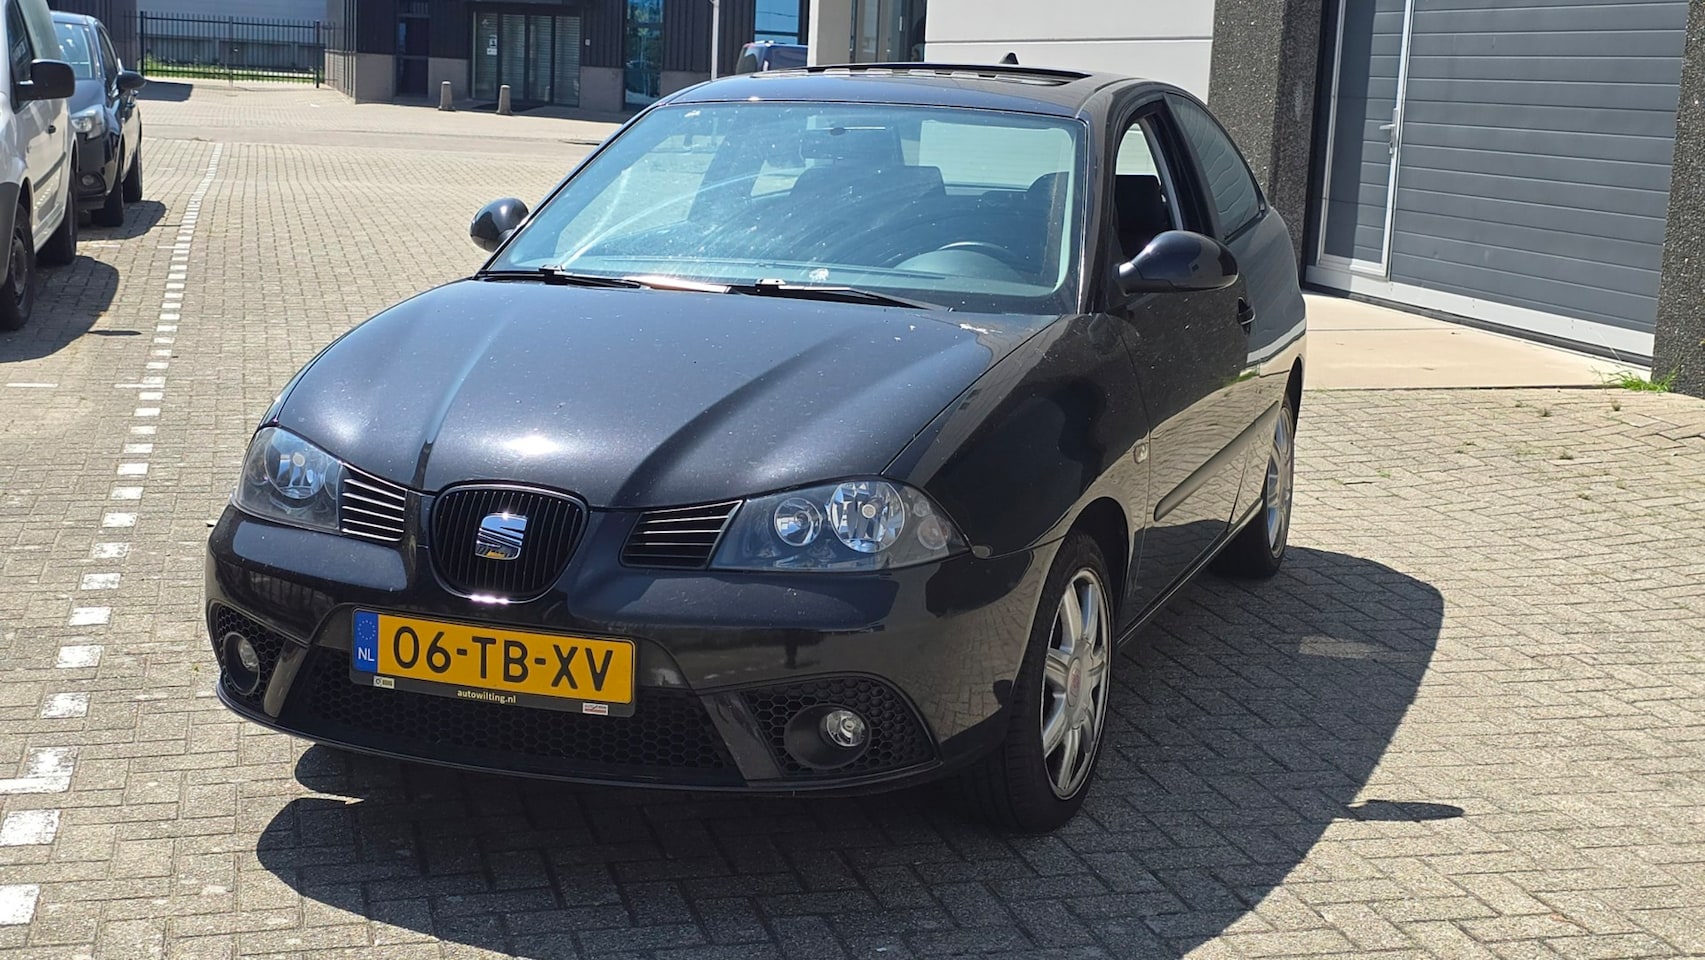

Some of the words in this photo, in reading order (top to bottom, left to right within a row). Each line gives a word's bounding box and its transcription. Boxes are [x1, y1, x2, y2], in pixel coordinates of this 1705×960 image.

[358, 646, 375, 662] NL
[393, 626, 613, 692] 06-TB-XV
[457, 689, 517, 704] autowilting.nl
